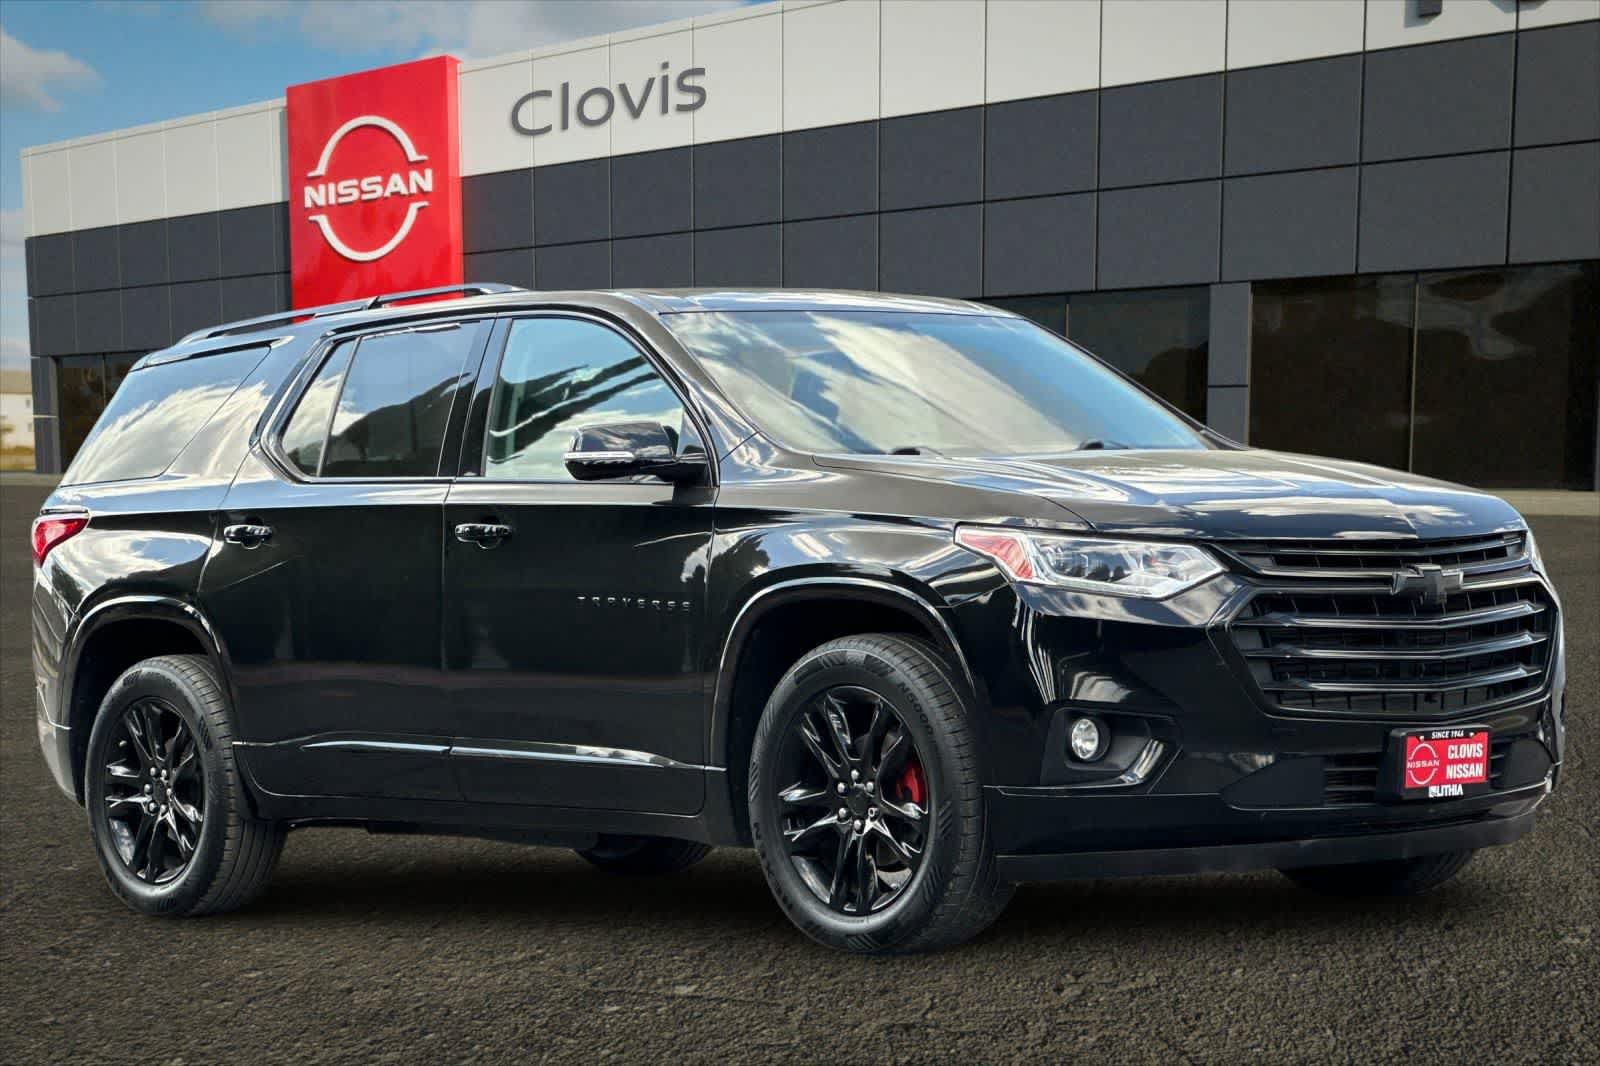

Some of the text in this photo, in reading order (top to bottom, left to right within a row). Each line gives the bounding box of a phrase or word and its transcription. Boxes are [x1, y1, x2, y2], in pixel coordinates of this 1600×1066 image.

[510, 62, 708, 136] Clovis
[304, 168, 433, 209] NISSAN
[1431, 731, 1450, 739] SINCE
[1448, 743, 1483, 759] CLOVIS
[1407, 759, 1440, 768] NISSAN
[1446, 763, 1483, 779] NISSAN
